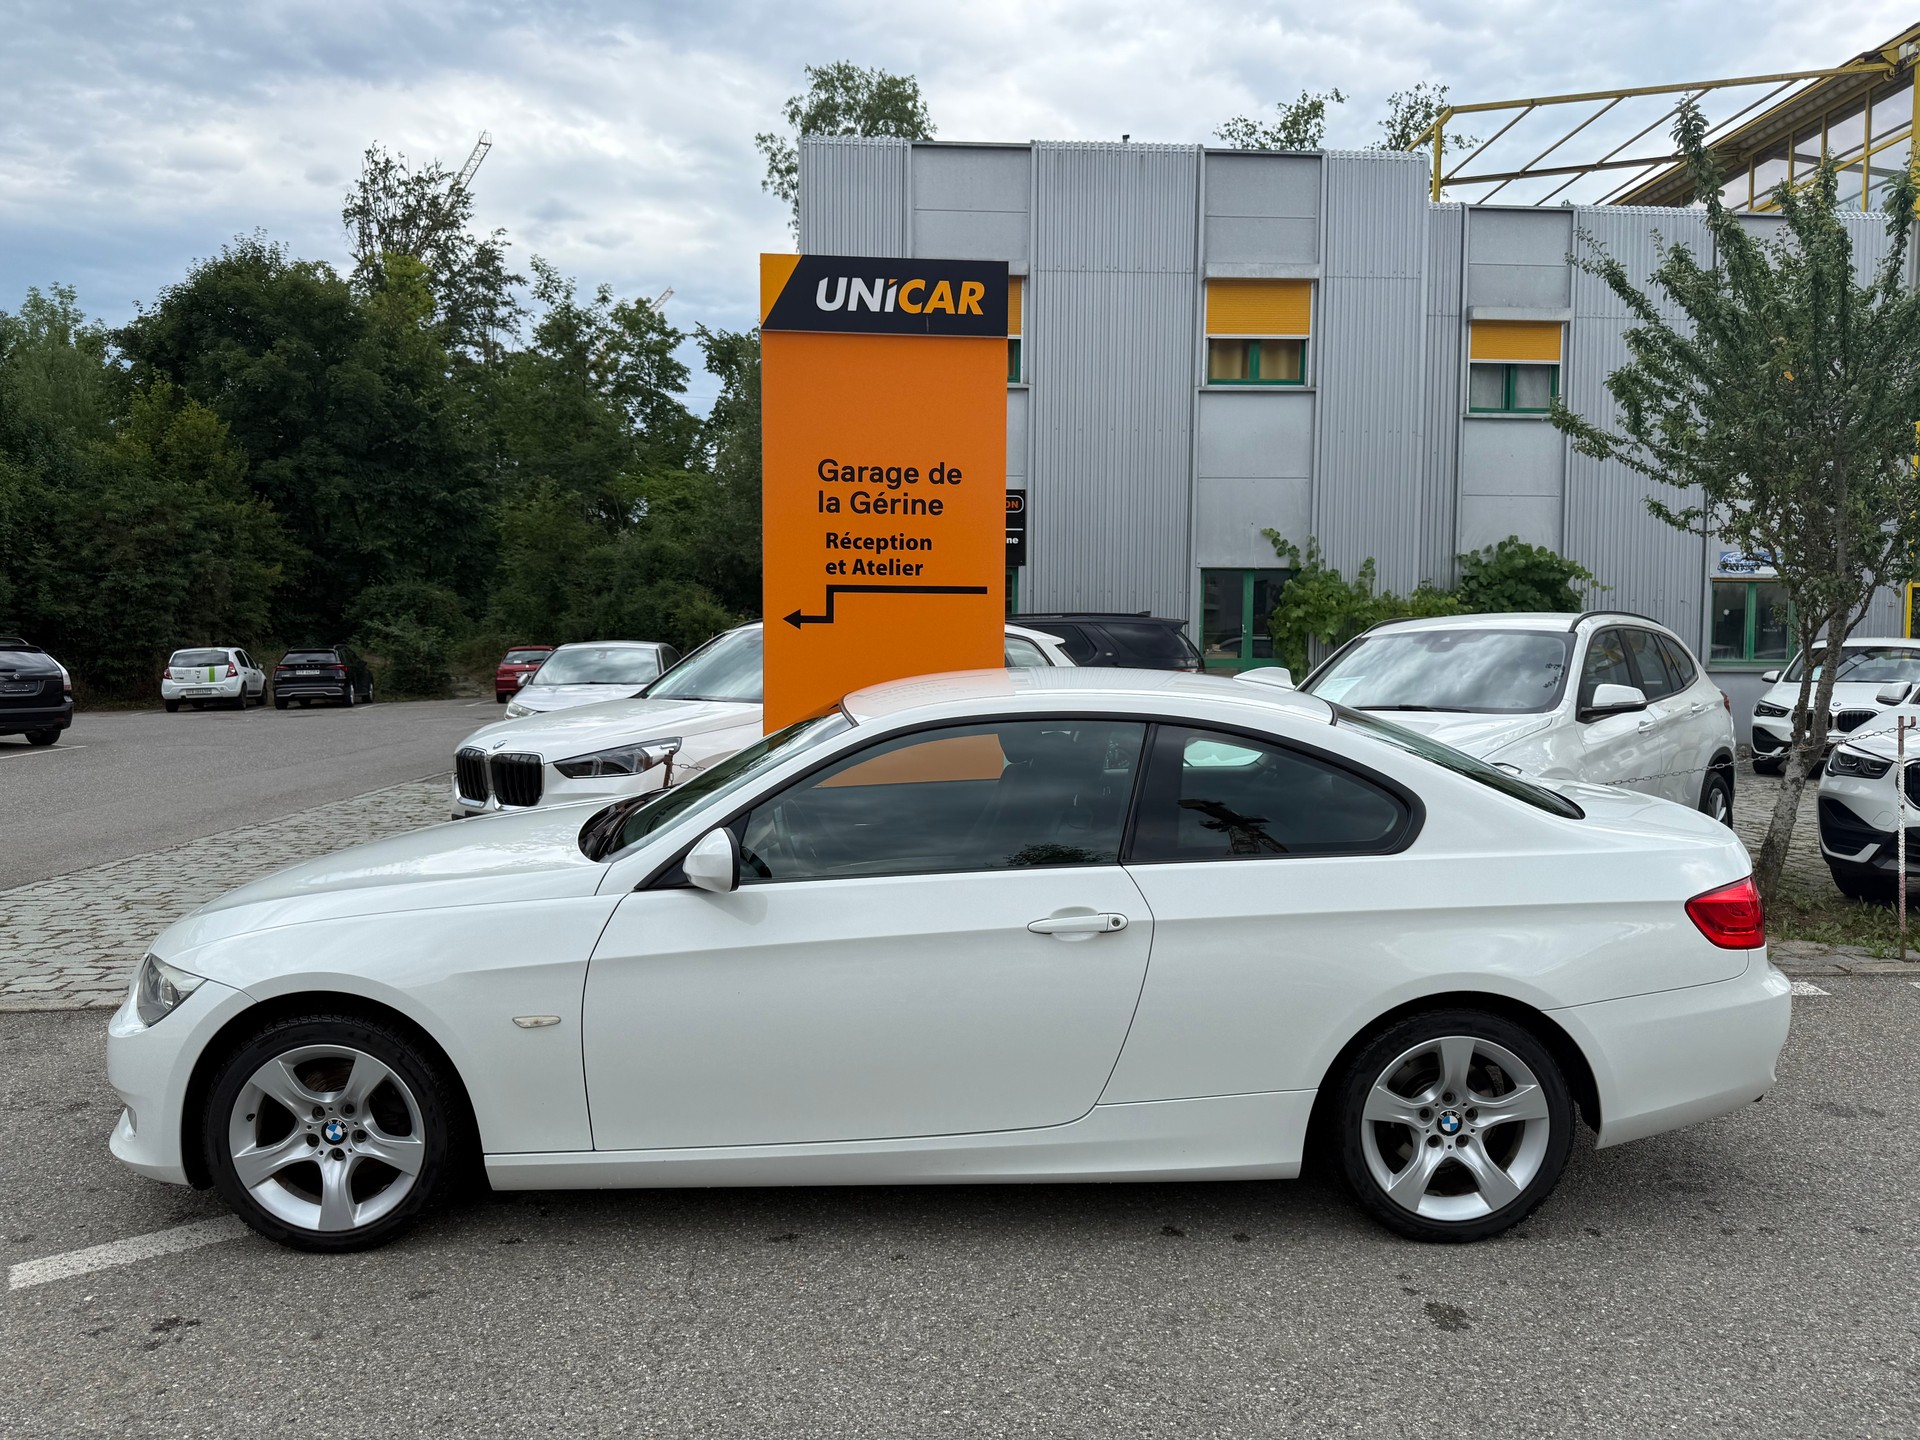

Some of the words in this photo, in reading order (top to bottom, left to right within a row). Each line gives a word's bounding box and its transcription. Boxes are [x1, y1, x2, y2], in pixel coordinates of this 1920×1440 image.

[817, 458, 920, 490] Garage
[928, 461, 963, 485] de
[818, 490, 841, 514] la
[849, 491, 944, 516] Gérine
[825, 532, 933, 555] Réception
[825, 562, 847, 576] et
[851, 558, 924, 577] Atelier
